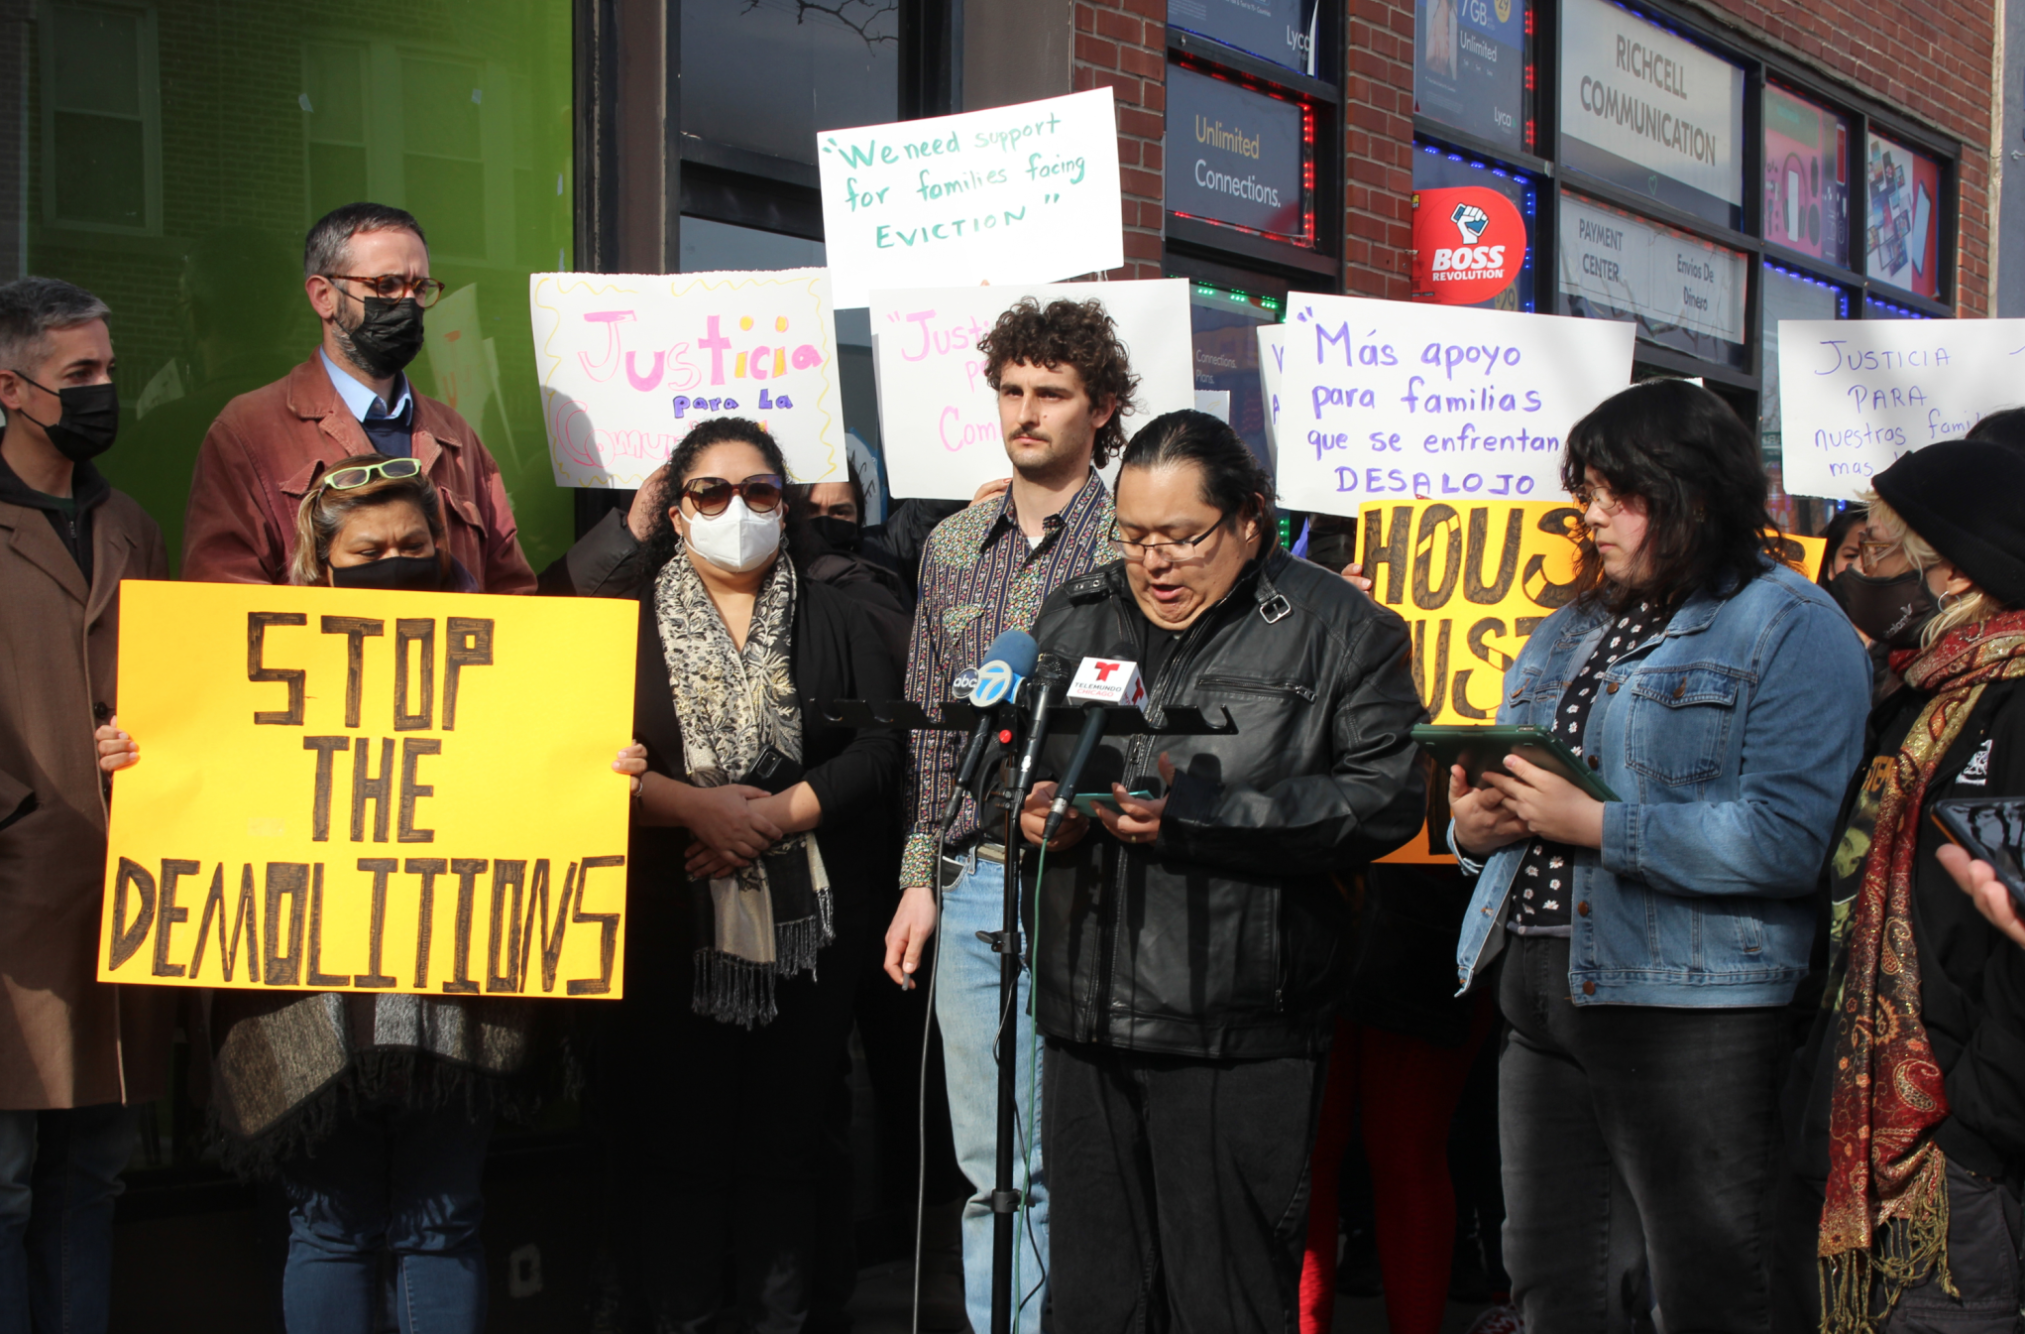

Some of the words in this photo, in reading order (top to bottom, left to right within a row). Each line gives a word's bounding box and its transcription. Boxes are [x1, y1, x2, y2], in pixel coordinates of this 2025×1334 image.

[1460, 30, 1497, 62] Unlimited
[1616, 33, 1687, 100] RICHCELL
[1494, 106, 1512, 127] Lyca
[1580, 75, 1716, 167] COMMUNICATION
[904, 131, 960, 160] need
[974, 113, 1061, 153] support
[1195, 114, 1260, 159] Unlimited
[845, 177, 890, 212] for
[916, 168, 1007, 201] families
[1025, 152, 1085, 184] facing
[1194, 158, 1281, 208] Connections.
[1579, 218, 1624, 251] PAYMENT
[1432, 245, 1506, 272] BOSS
[1432, 269, 1504, 281] REVOLUTION
[1582, 253, 1620, 283] CENTER
[1704, 262, 1715, 284] De
[1683, 286, 1709, 312] Dinero
[577, 309, 824, 392] Justicia
[1420, 342, 1521, 381] apoyo
[1814, 339, 1952, 375] JUSTICIA
[673, 394, 740, 419] para
[758, 388, 794, 410] La
[1311, 385, 1375, 419] para
[1400, 375, 1543, 413] familias
[1847, 384, 1928, 414] PARA
[1307, 429, 1349, 461] que
[1369, 431, 1403, 452] se
[1423, 422, 1560, 453] enfrentan
[1335, 466, 1535, 496] DESALOJO
[1829, 461, 1874, 477] mas
[247, 611, 495, 732] STOP
[953, 674, 977, 688] abc
[1075, 682, 1122, 692] TELEMUNDO
[1077, 688, 1114, 697] CHICAGO
[303, 735, 442, 843] THE
[108, 855, 626, 996] DEMOLITIONS
